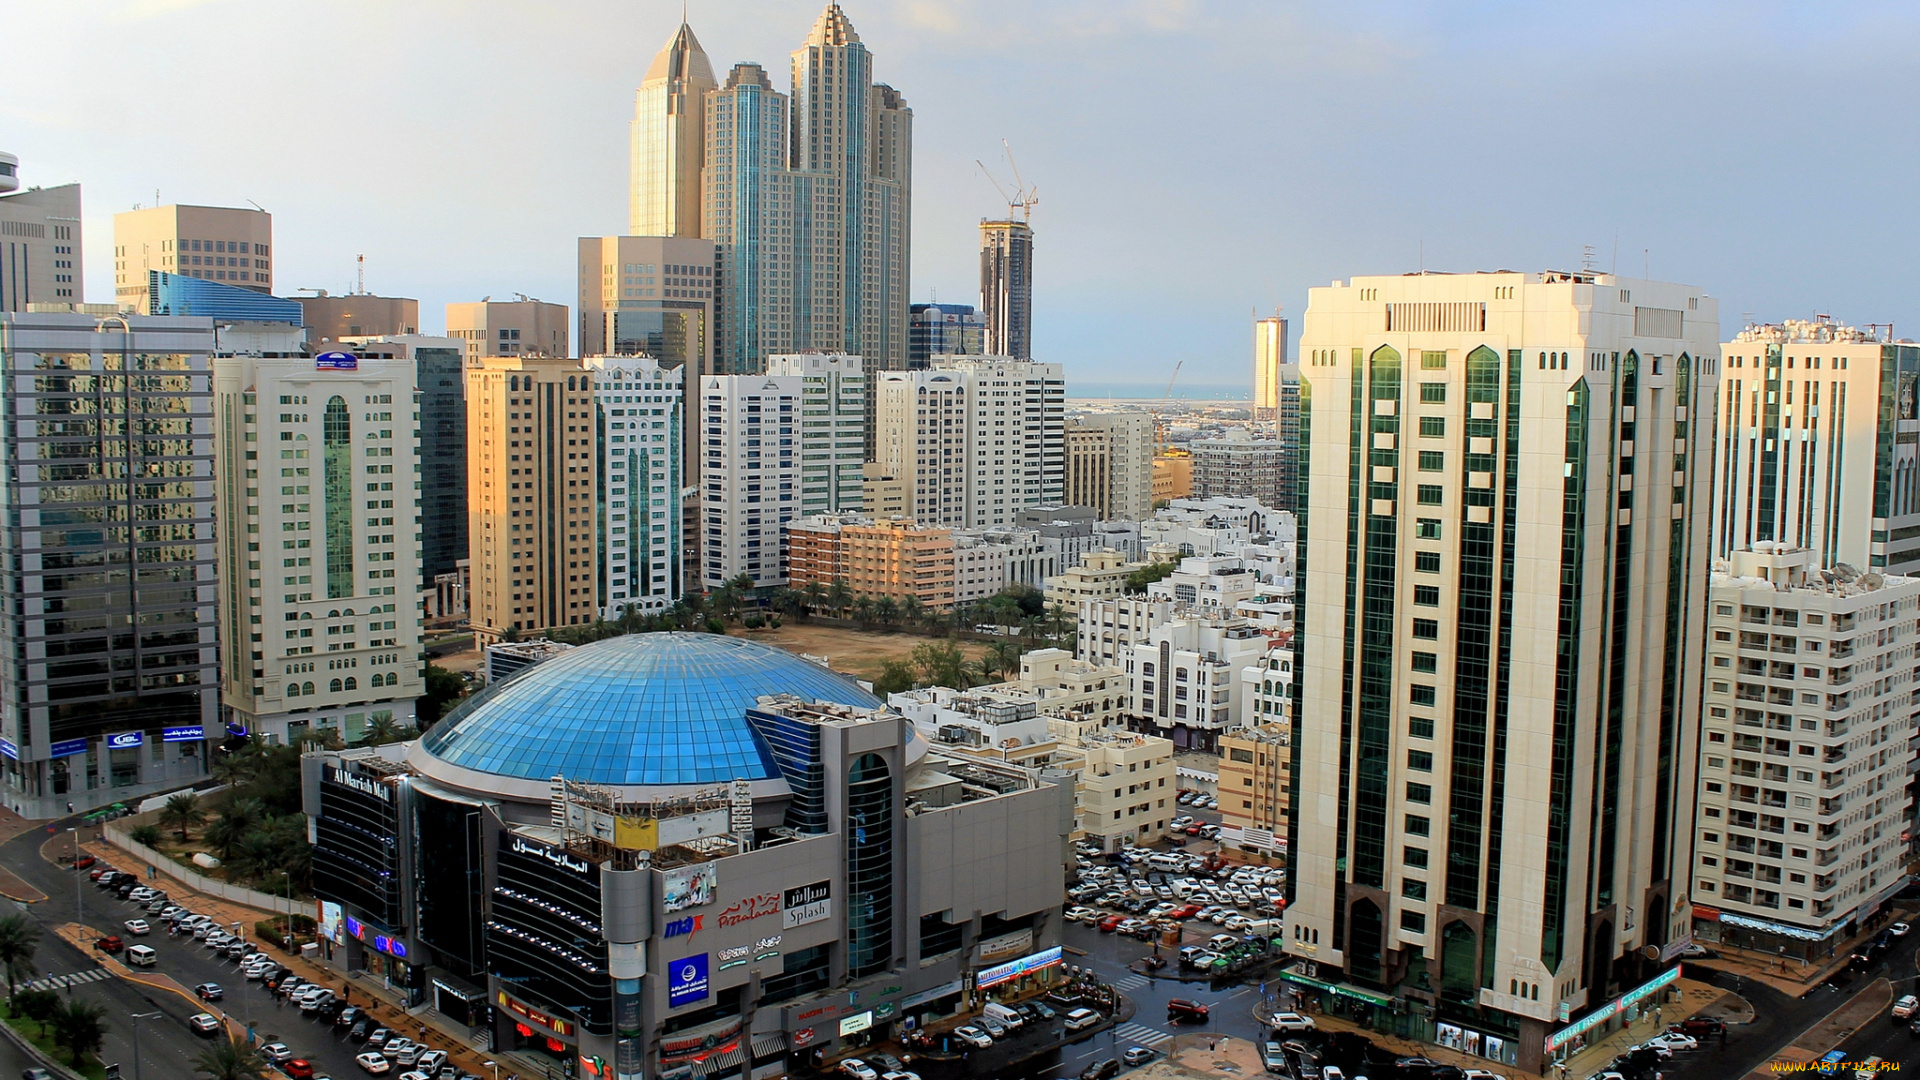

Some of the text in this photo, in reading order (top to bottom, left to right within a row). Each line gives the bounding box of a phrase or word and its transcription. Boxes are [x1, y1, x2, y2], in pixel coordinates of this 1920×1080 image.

[334, 769, 390, 803] Al Mariah Mall
[788, 886, 827, 907] سبلاش
[718, 903, 781, 928] Pizzaland
[790, 901, 825, 925] Splash
[664, 914, 705, 945] max
